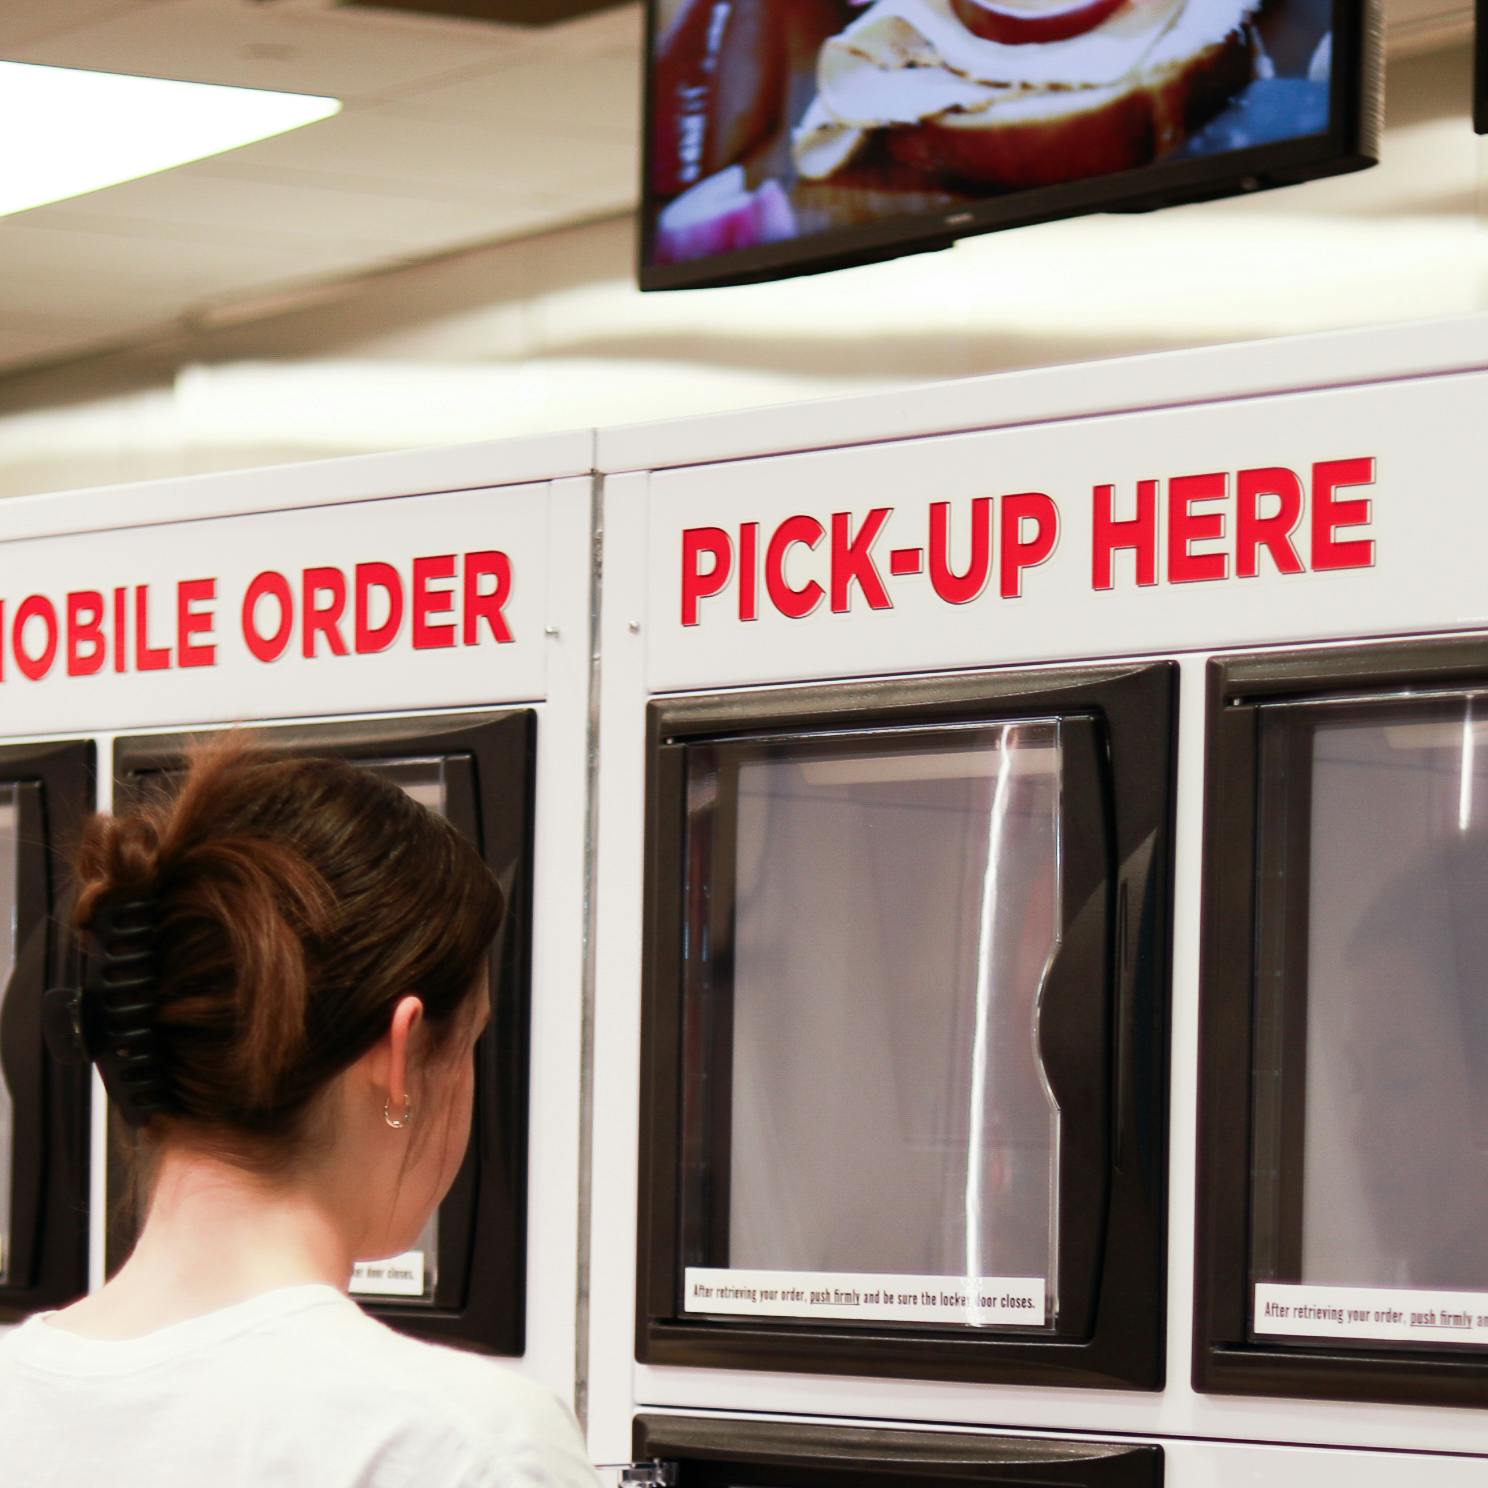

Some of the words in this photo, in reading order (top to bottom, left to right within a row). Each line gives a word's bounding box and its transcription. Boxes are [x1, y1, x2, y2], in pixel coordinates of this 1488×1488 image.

[680, 491, 1058, 627] PICK-UP
[1091, 456, 1375, 592] HERE
[241, 550, 515, 664] ORDER
[694, 1284, 713, 1297] After
[716, 1286, 757, 1303] retrieving
[760, 1289, 778, 1303] your
[781, 1287, 807, 1303] order,
[810, 1288, 831, 1304] push
[834, 1288, 860, 1305] firmly
[864, 1290, 880, 1304] and
[883, 1290, 894, 1305] be
[897, 1294, 918, 1306] sure
[921, 1292, 937, 1307] the
[940, 1291, 969, 1307] locke
[1000, 1293, 1035, 1309] closes.
[1264, 1301, 1289, 1318] After
[1293, 1304, 1344, 1324] retrieving
[1347, 1309, 1371, 1323] your
[1374, 1307, 1407, 1325] order,
[1410, 1309, 1436, 1326] push
[1440, 1310, 1472, 1328] firmly
